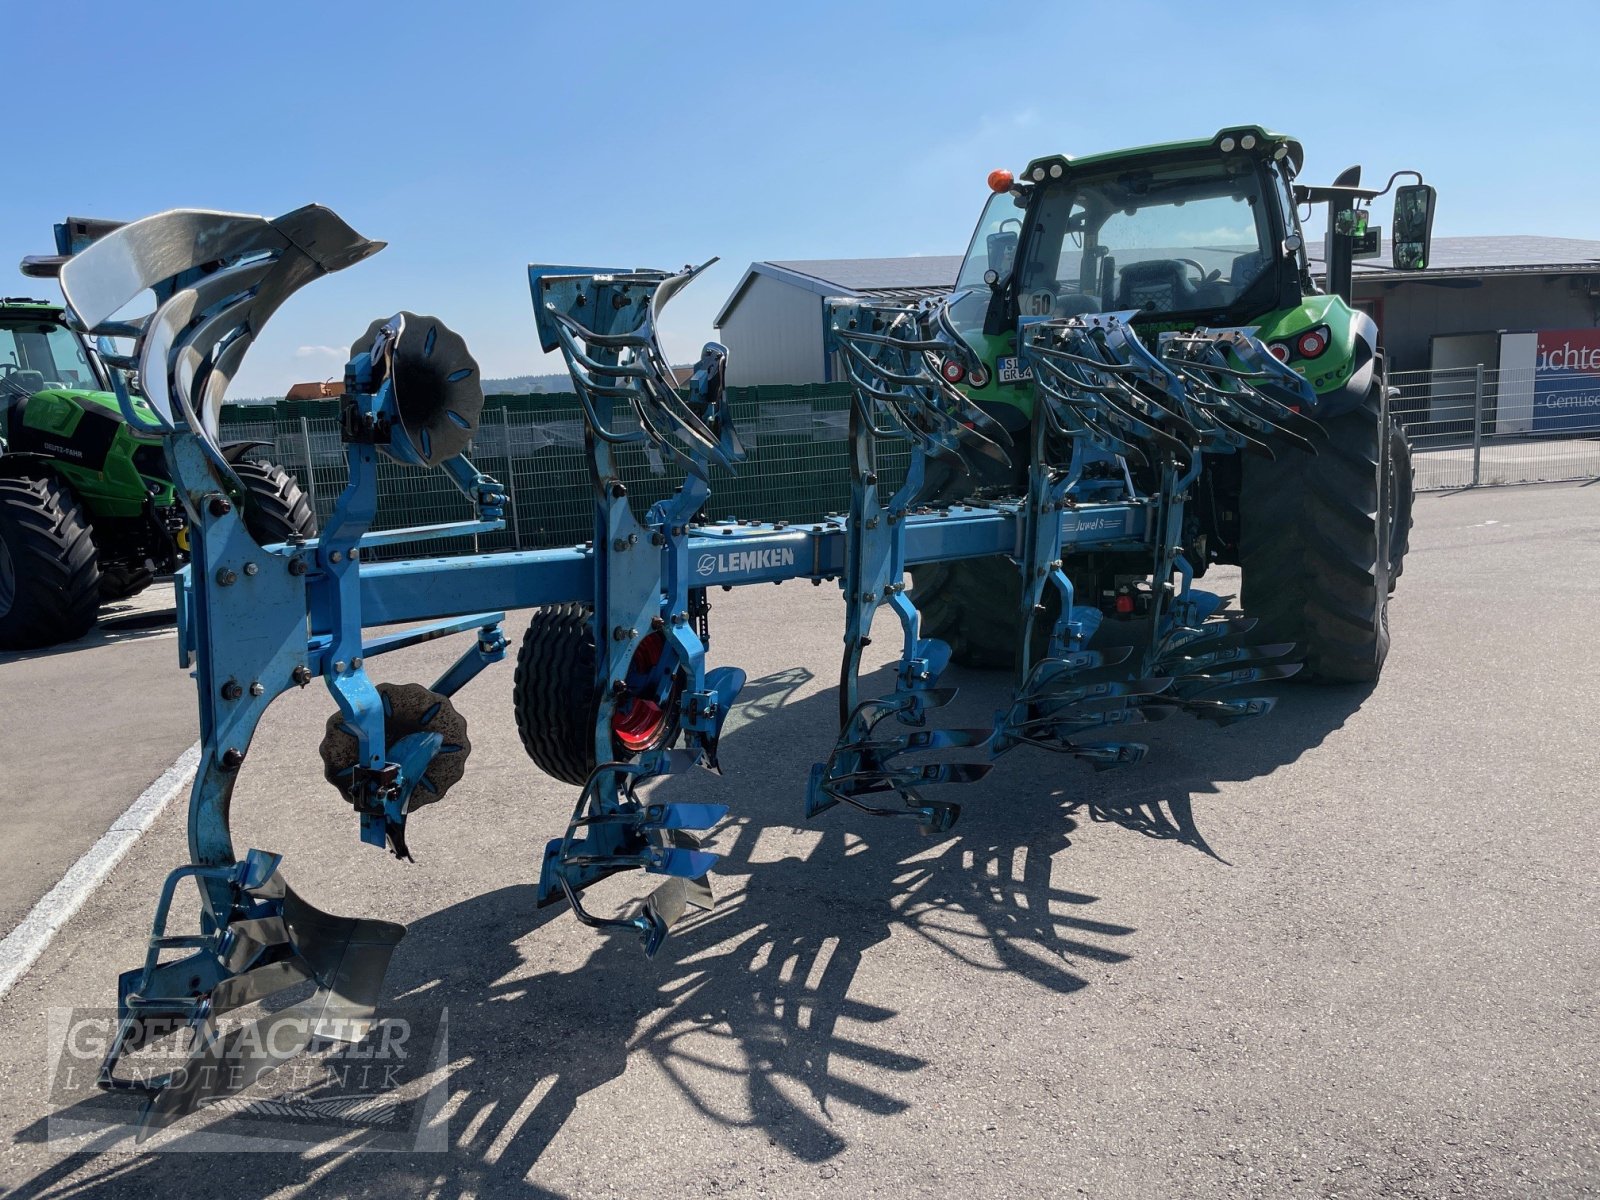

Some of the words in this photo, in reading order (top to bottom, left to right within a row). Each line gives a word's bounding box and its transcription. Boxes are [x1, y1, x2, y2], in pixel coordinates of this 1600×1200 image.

[1031, 294, 1051, 316] 50
[1075, 518, 1098, 532] Juwel
[718, 547, 794, 574] LEMKEN
